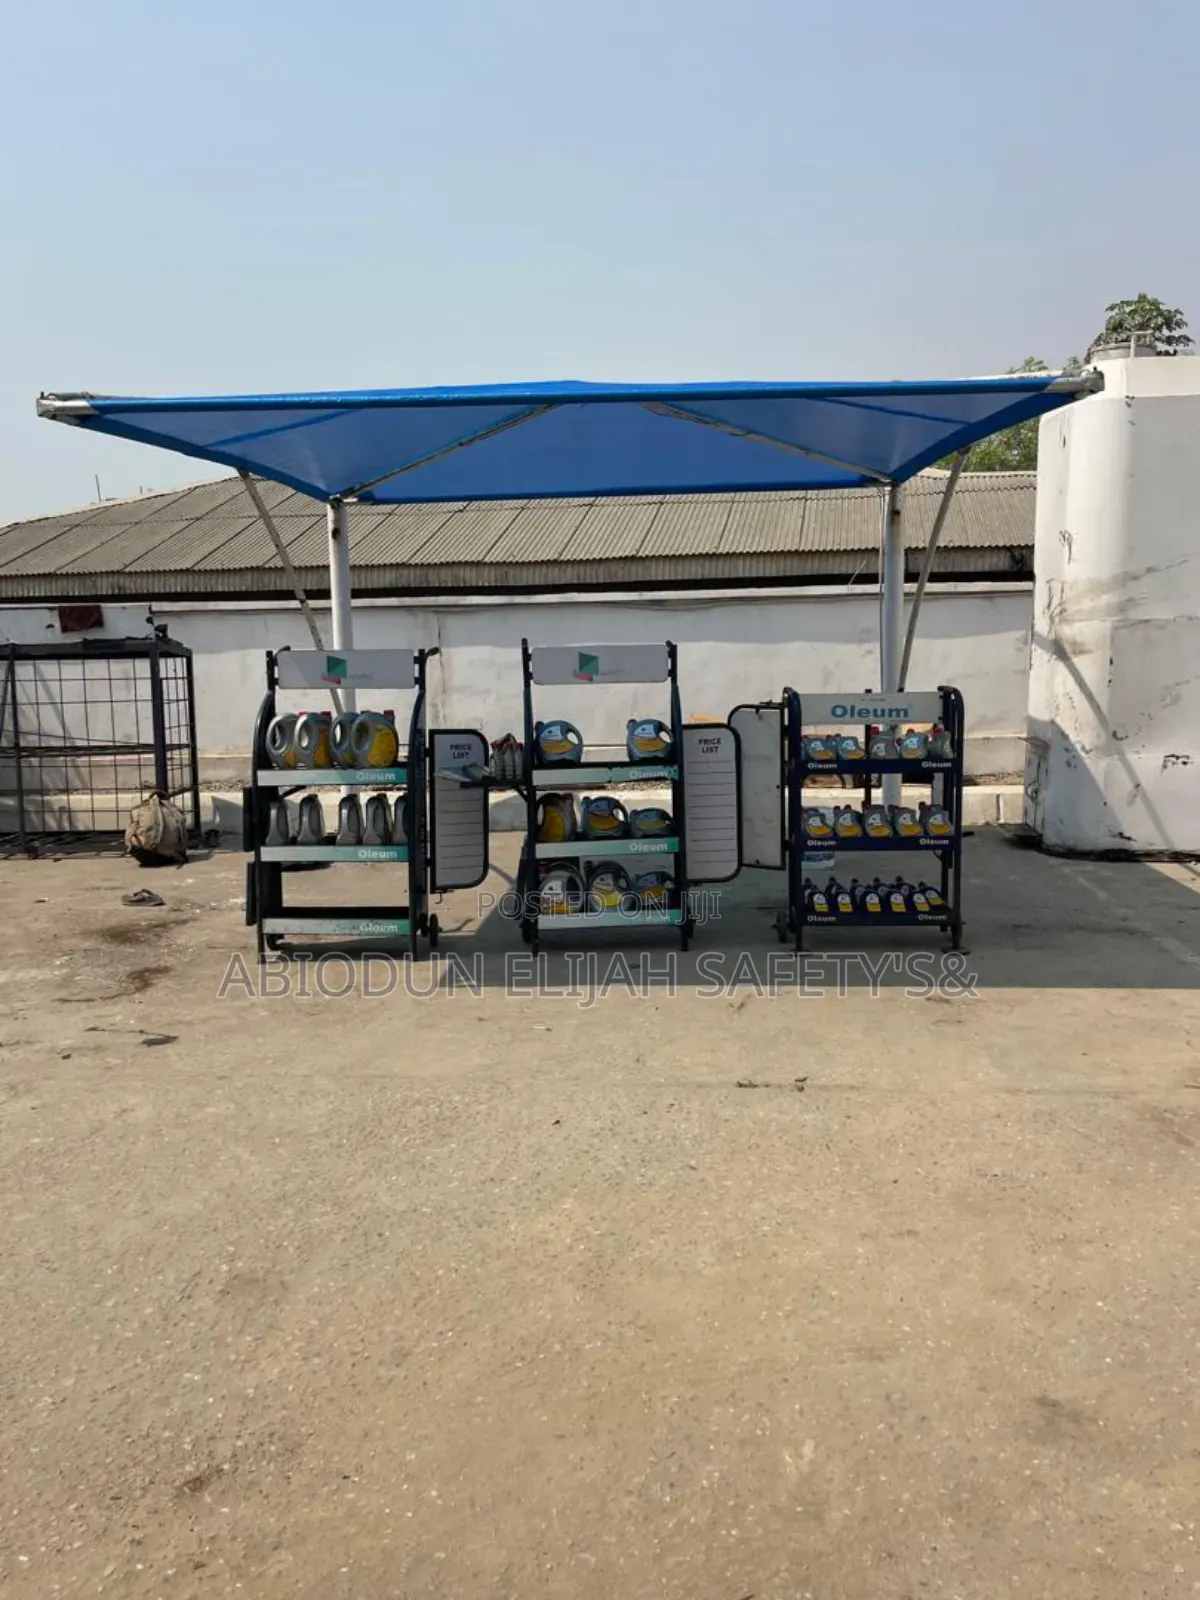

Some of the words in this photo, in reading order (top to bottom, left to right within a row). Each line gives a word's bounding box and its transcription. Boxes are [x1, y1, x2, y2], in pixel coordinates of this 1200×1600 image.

[830, 704, 909, 719] Oleum
[698, 738, 722, 746] PRICE
[450, 743, 472, 751] PRICE
[701, 746, 719, 754] LIST
[452, 751, 470, 760] LIST
[356, 771, 396, 781] Oleum
[630, 842, 668, 852] Oleum
[358, 849, 397, 859] Oleum
